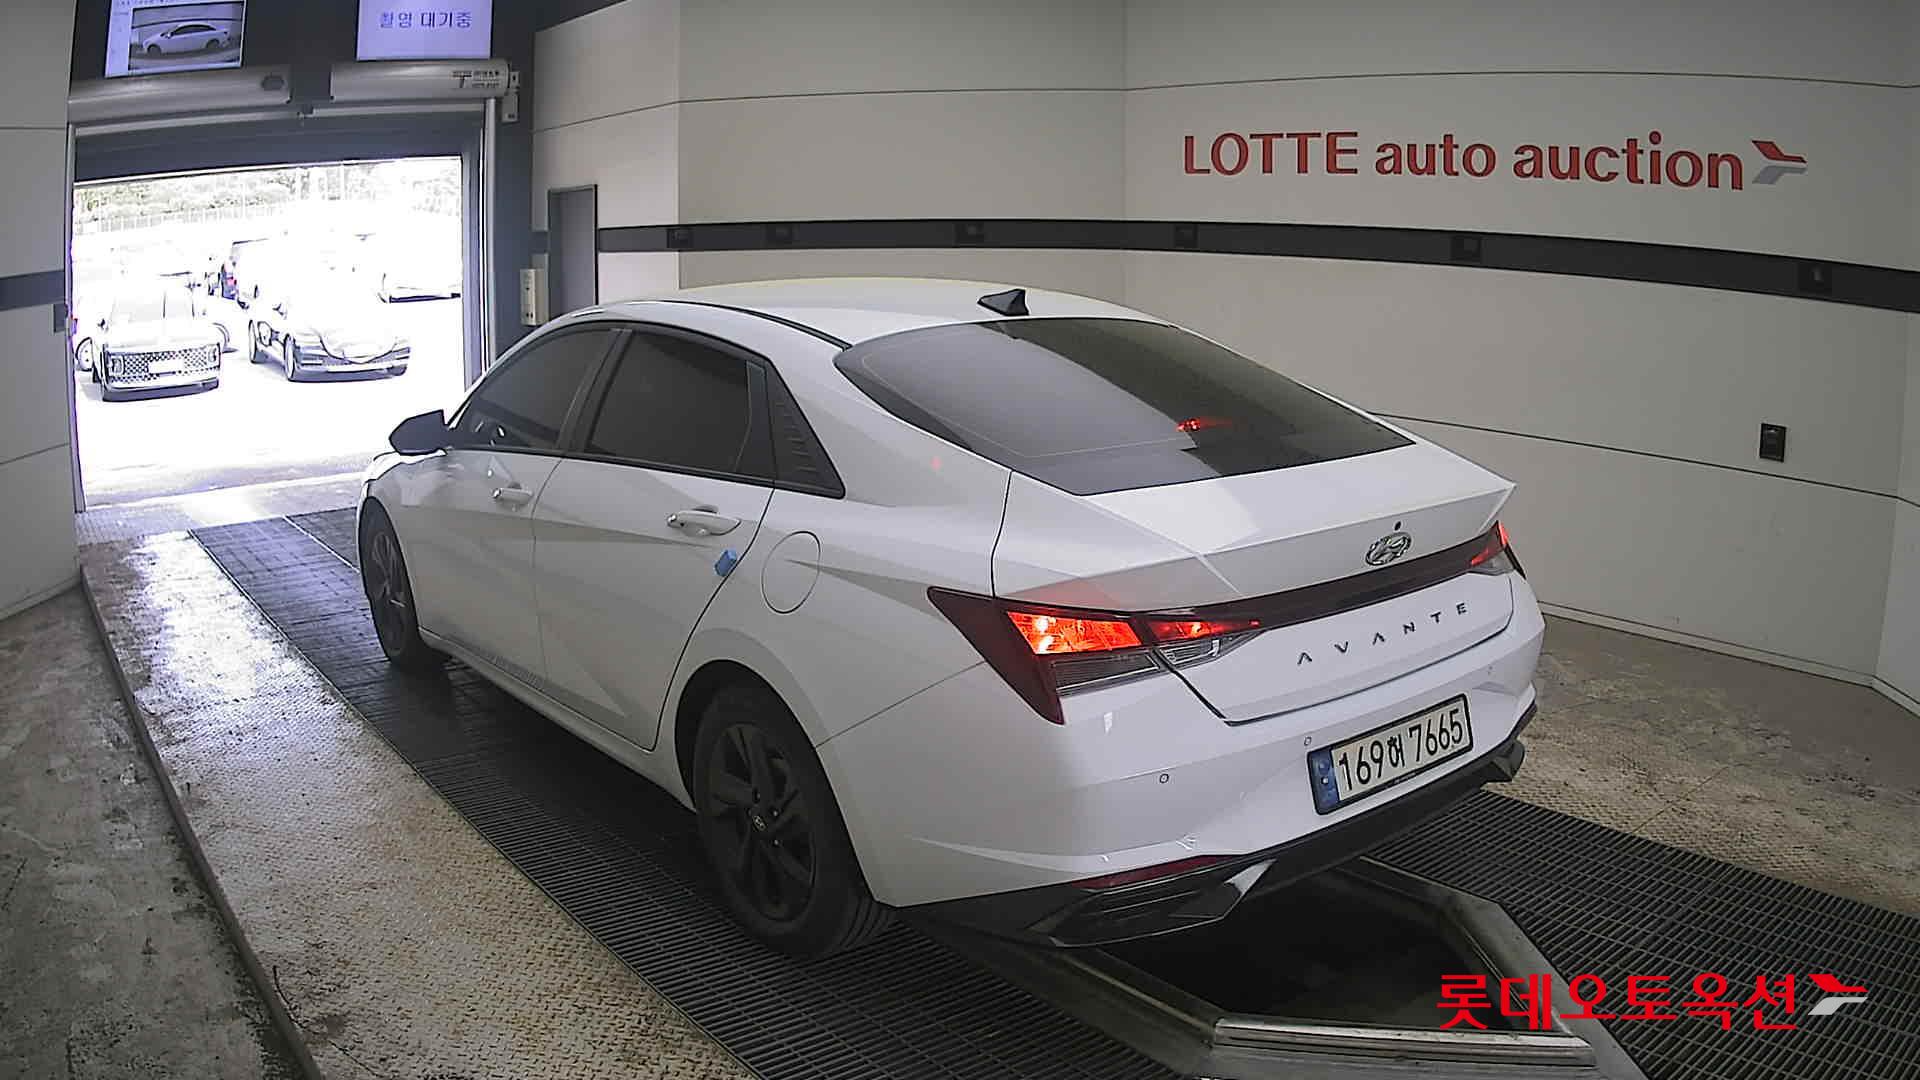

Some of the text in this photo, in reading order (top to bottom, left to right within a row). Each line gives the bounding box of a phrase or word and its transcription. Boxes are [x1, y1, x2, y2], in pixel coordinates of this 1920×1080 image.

[420, 11, 472, 28] 대기중
[1184, 131, 1744, 190] LOTTE auto auction
[1296, 602, 1468, 666] AVANTE
[1338, 736, 1405, 792] 169허
[1409, 709, 1463, 762] 7665
